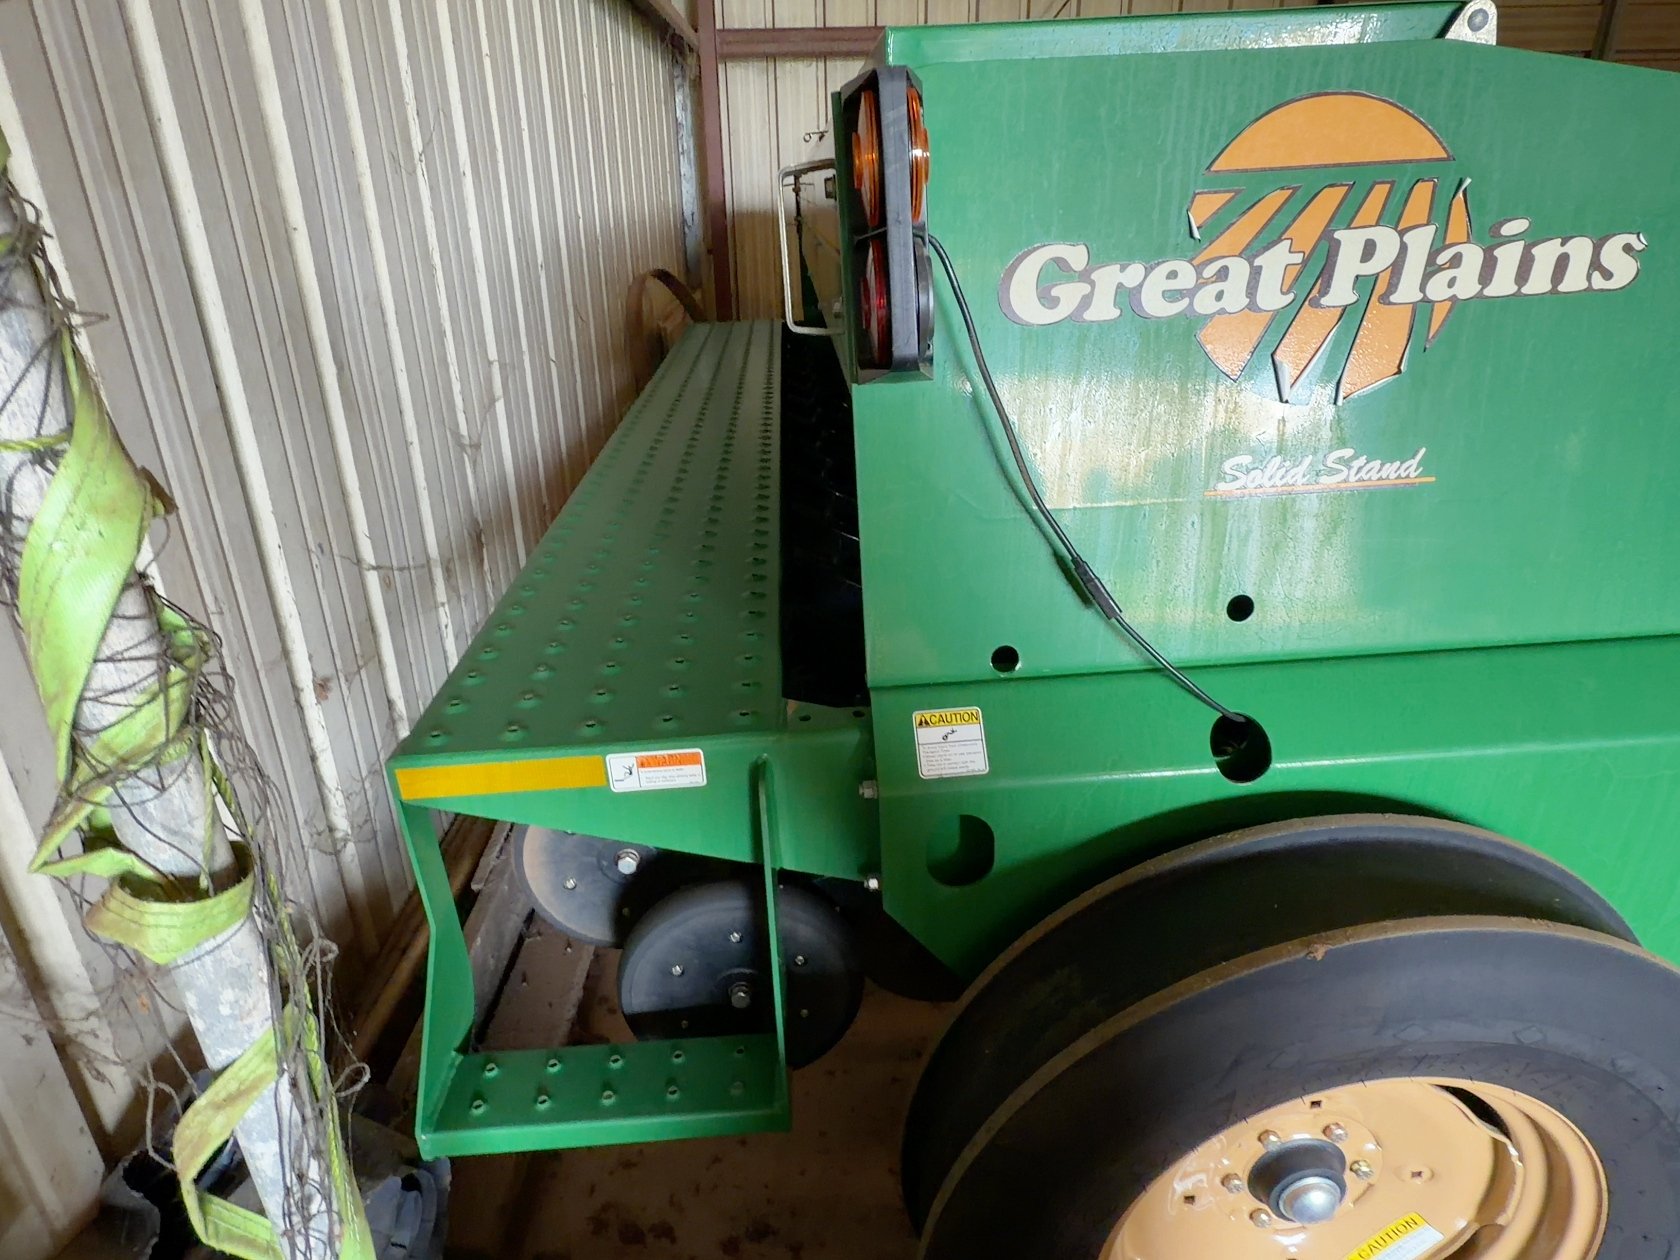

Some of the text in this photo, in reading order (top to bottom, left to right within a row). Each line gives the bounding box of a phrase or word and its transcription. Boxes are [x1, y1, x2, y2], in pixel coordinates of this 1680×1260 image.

[1000, 218, 1648, 326] Great Plains
[1214, 447, 1427, 491] Solid Stand
[929, 711, 979, 726] CAUTION
[1357, 1216, 1418, 1260] CAUTION
